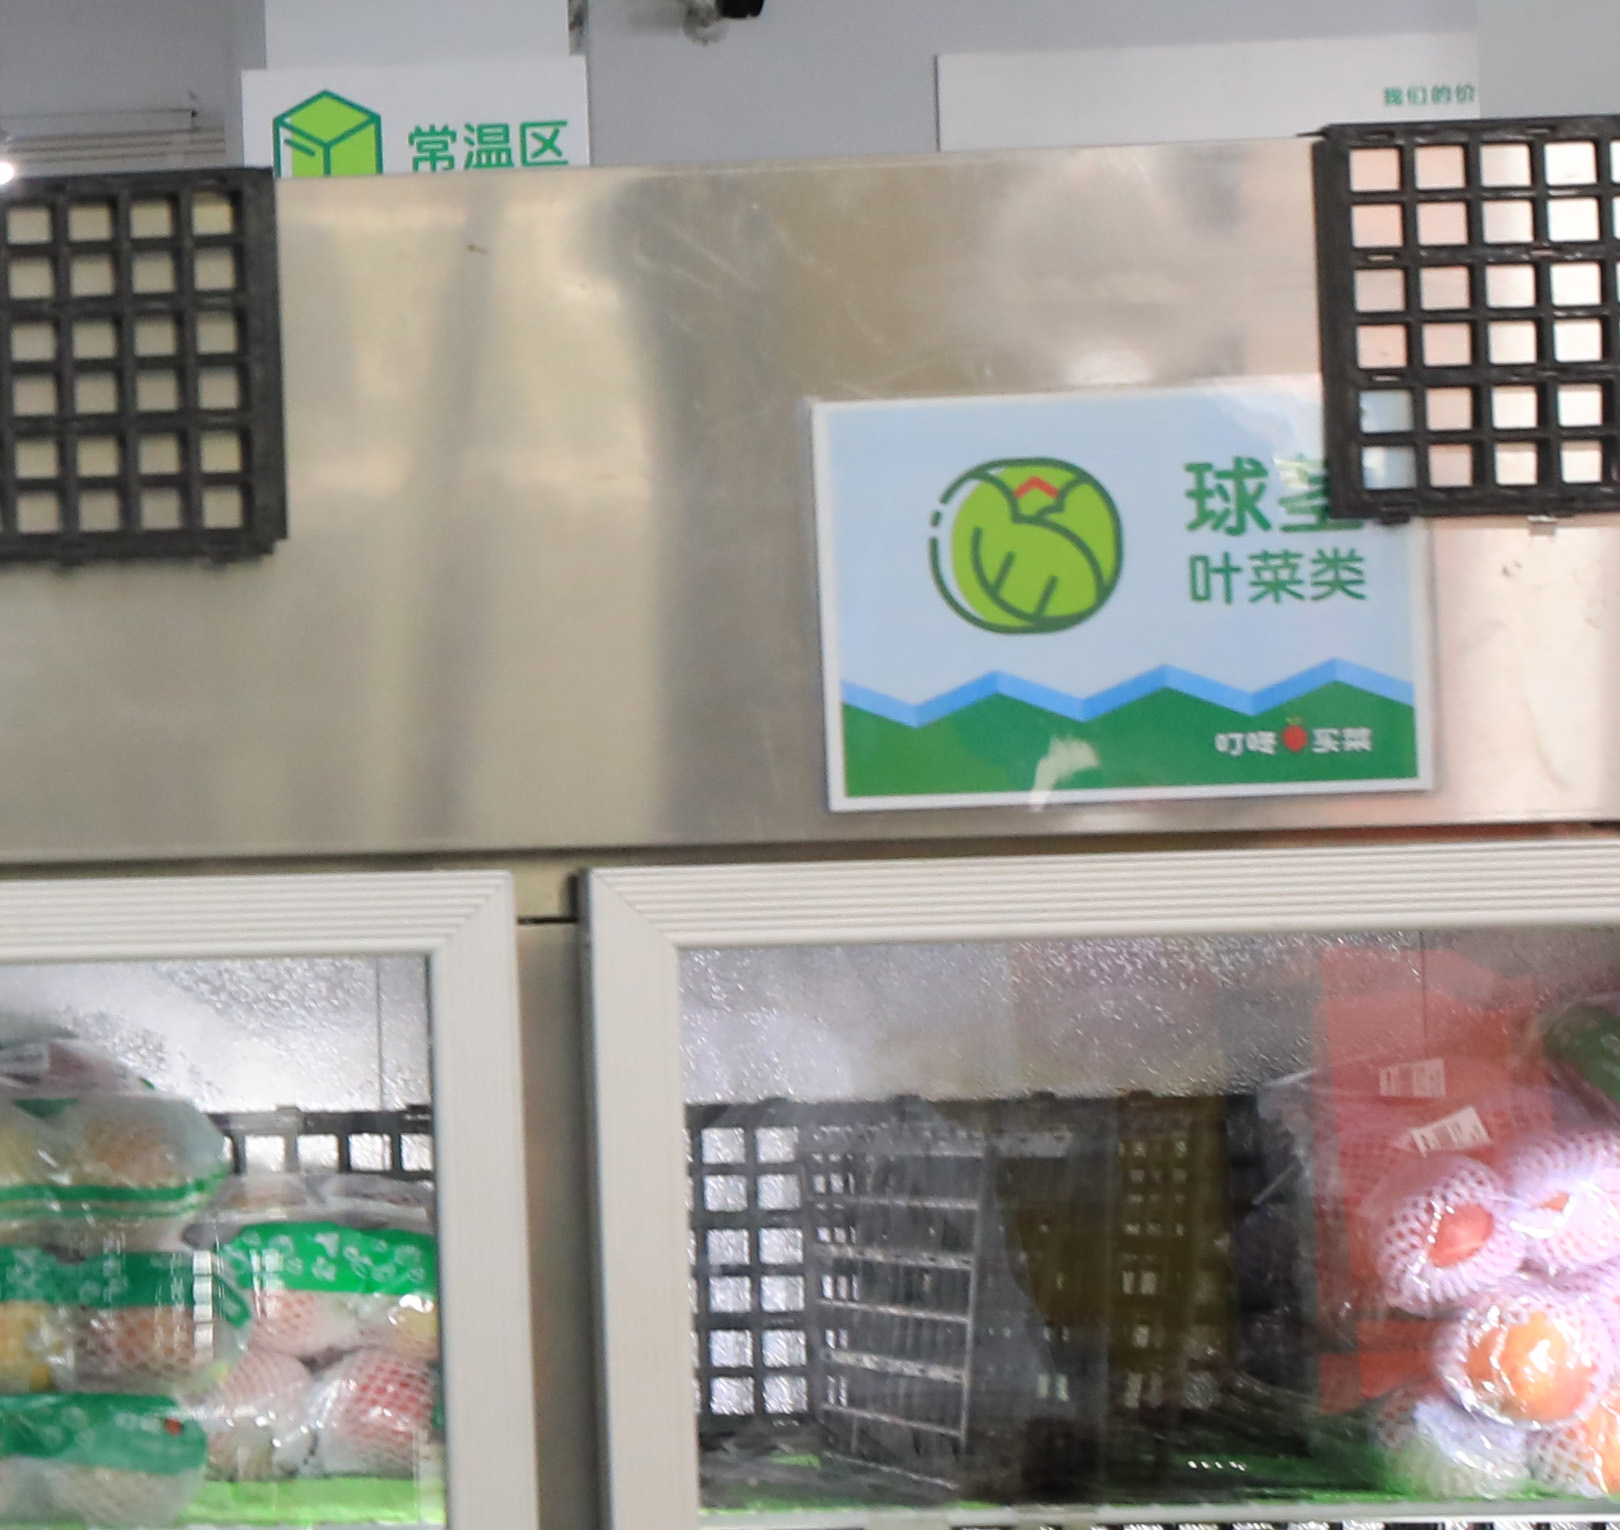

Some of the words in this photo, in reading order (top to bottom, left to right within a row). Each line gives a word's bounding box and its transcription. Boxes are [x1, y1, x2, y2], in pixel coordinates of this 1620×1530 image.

[408, 120, 568, 172] 常温区
[1189, 548, 1366, 604] 叶菜类
